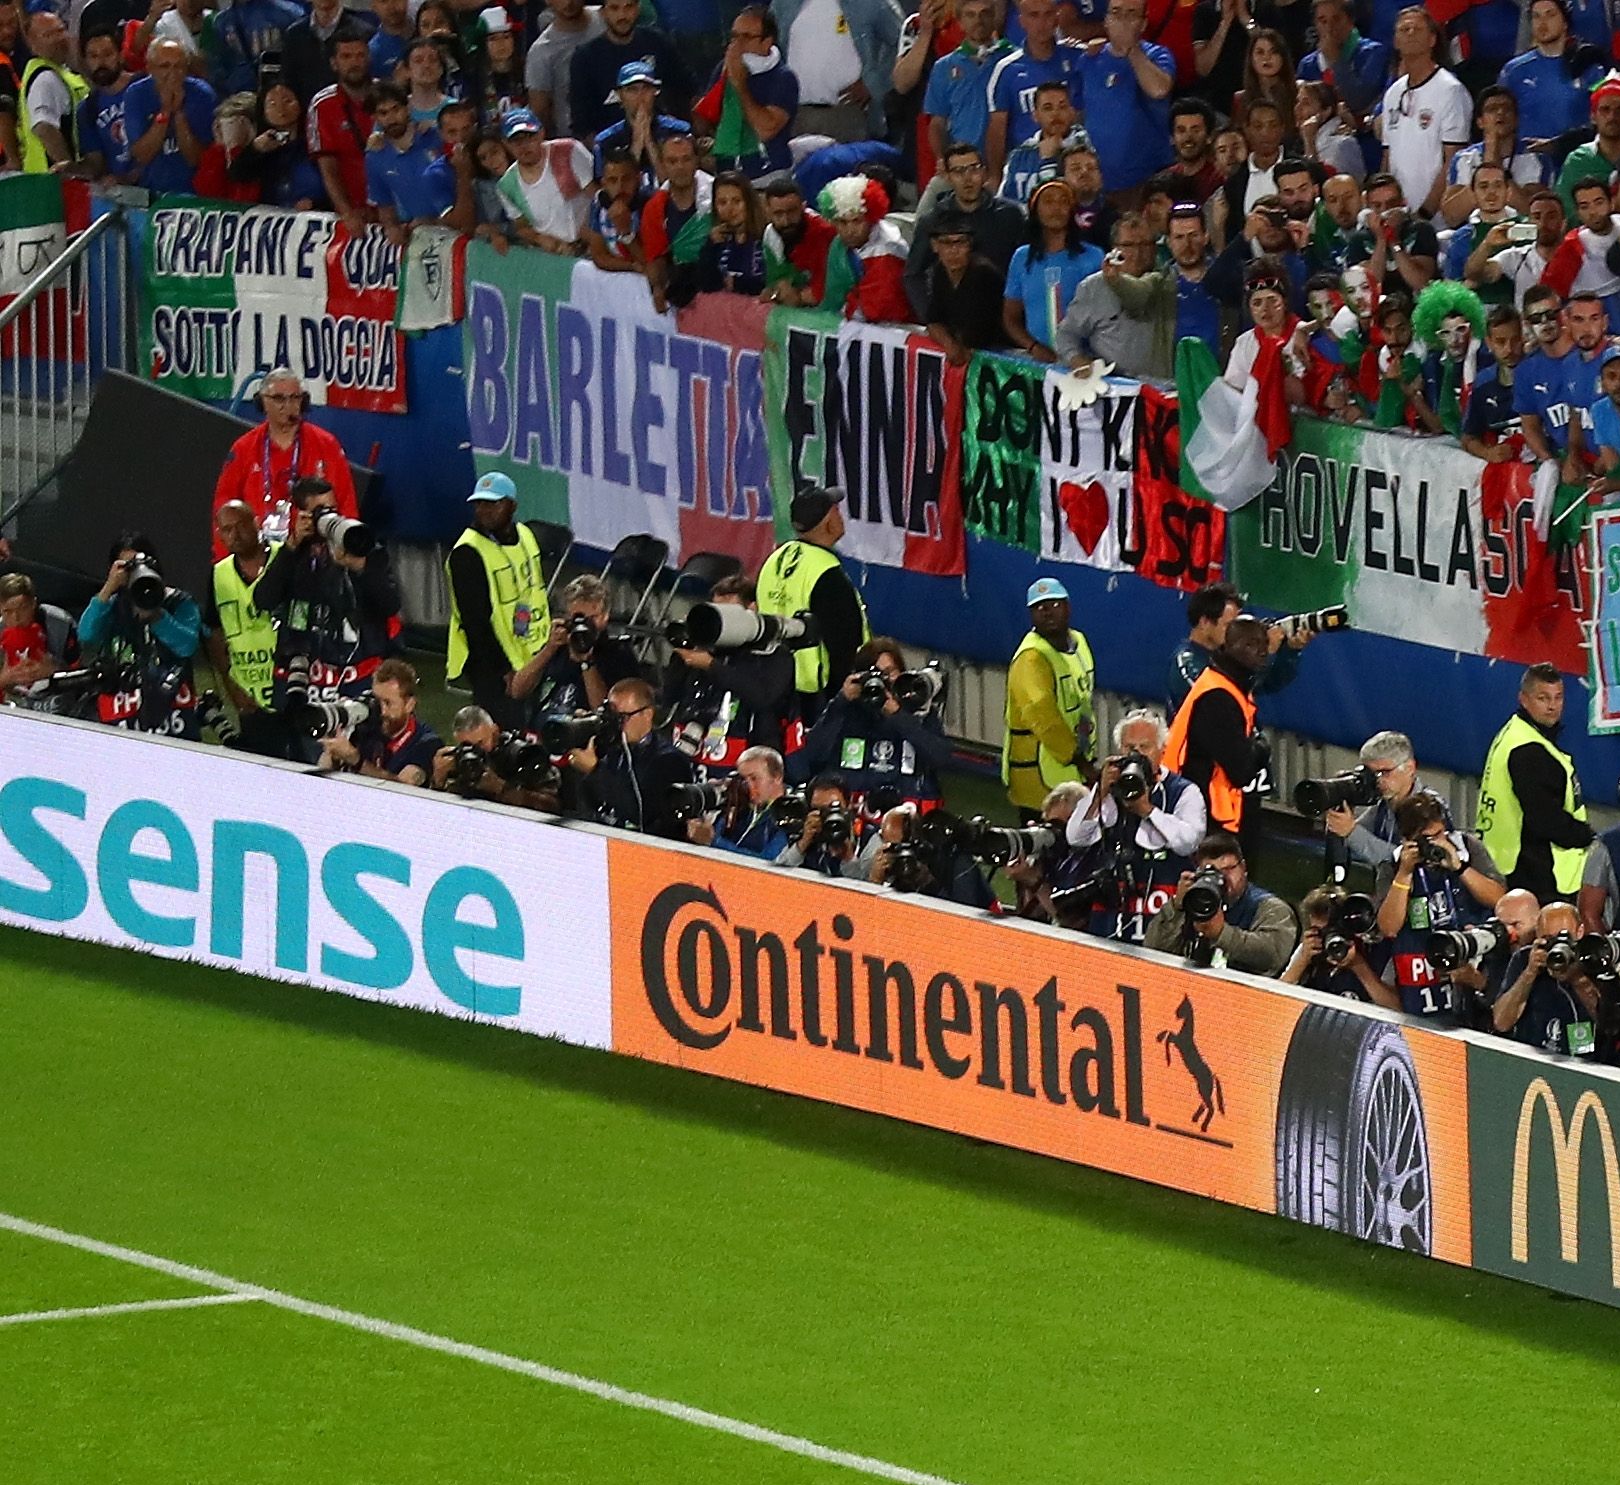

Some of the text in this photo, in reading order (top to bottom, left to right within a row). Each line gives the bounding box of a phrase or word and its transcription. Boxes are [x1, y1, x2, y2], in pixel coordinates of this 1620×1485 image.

[153, 211, 399, 295] TRAPANI E' QUA
[153, 306, 399, 391] SOTTO LA DOCCIA
[468, 281, 774, 523] BARLETTA
[786, 325, 946, 541] ENNA
[0, 776, 525, 1016] sense
[641, 882, 1150, 1128] Continental
